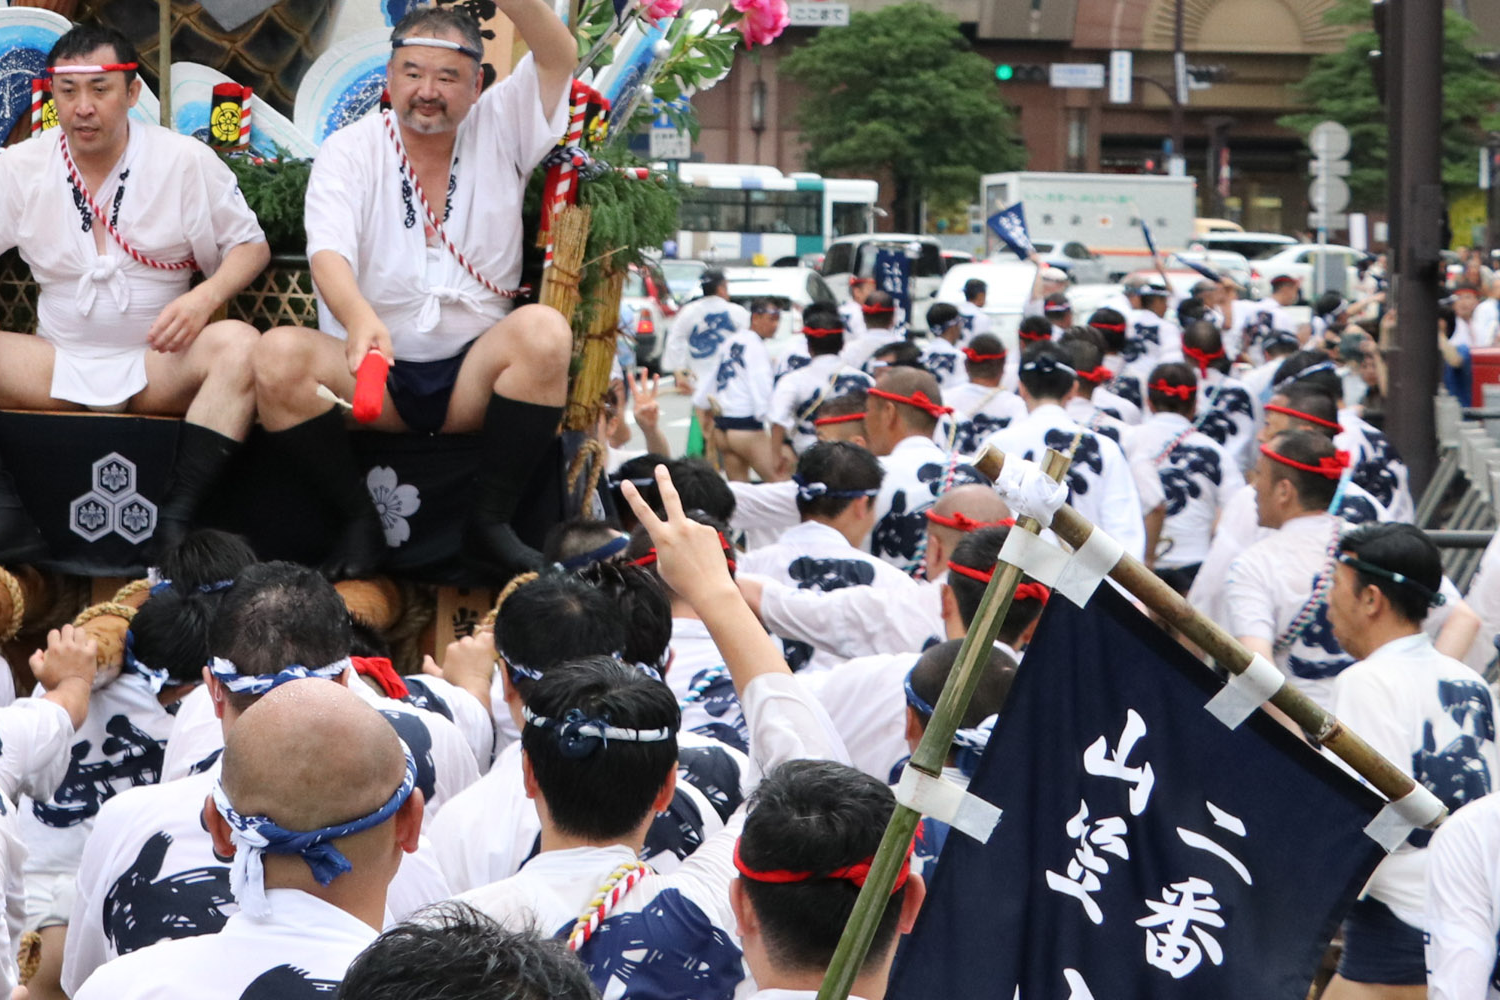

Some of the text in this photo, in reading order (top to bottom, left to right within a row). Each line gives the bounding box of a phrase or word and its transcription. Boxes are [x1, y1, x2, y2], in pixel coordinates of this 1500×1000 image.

[794, 7, 845, 21] ここまで
[1045, 708, 1156, 925] 山笠
[1135, 801, 1253, 979] 二番
